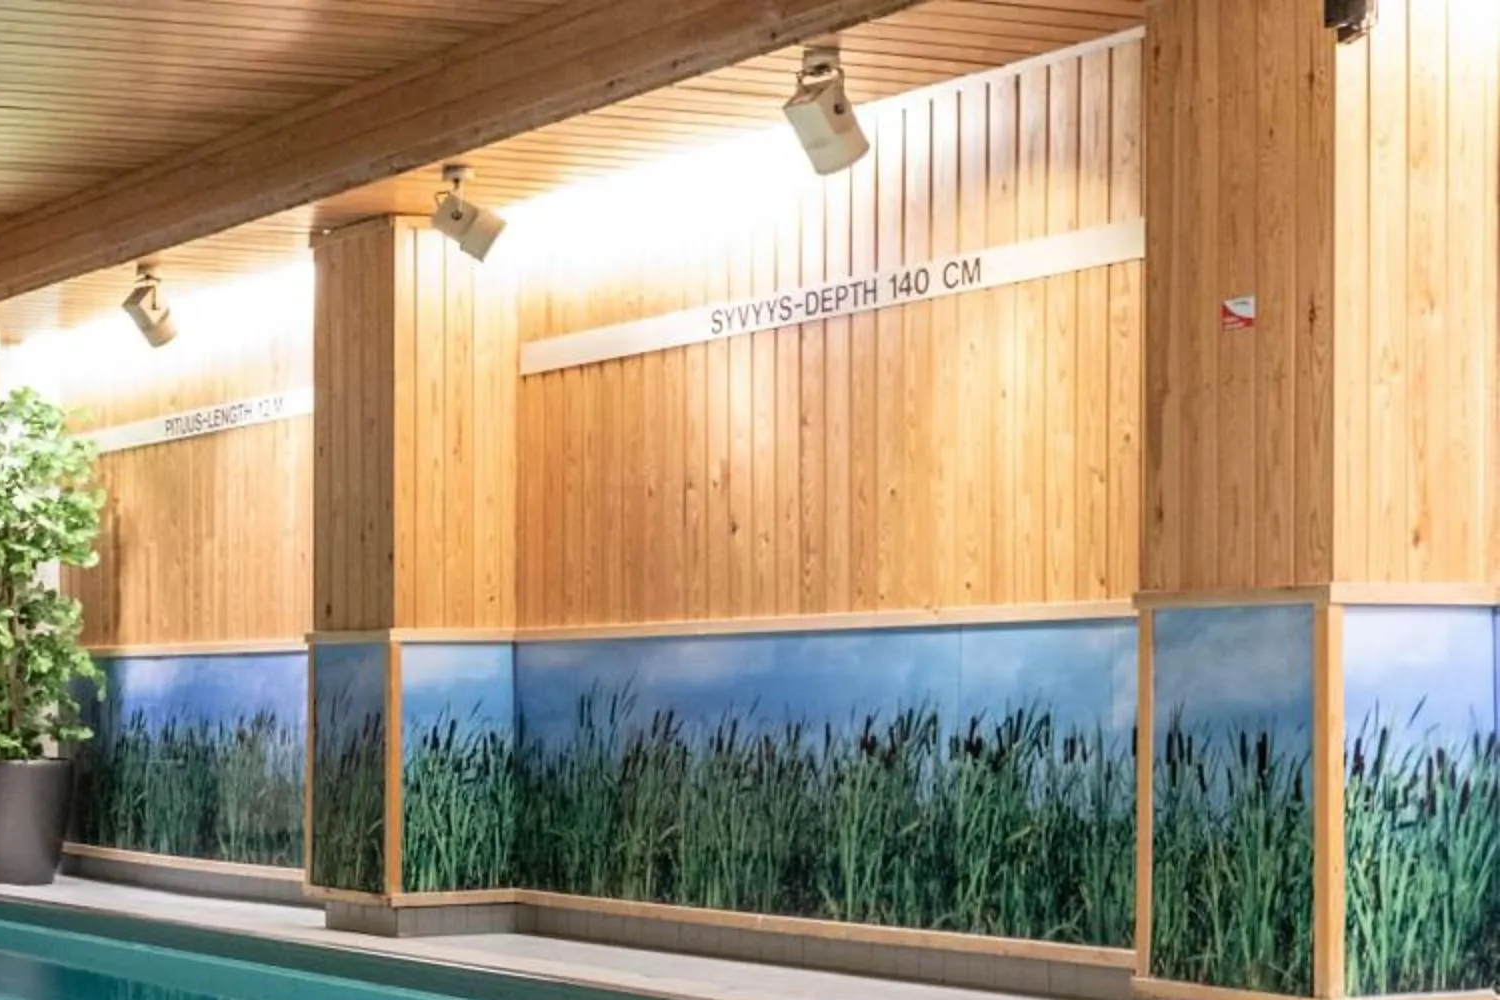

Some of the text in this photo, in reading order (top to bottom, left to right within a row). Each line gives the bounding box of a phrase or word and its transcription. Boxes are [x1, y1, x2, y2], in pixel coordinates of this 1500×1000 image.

[710, 256, 982, 335] SYVYYS-DEPTH 140 CM
